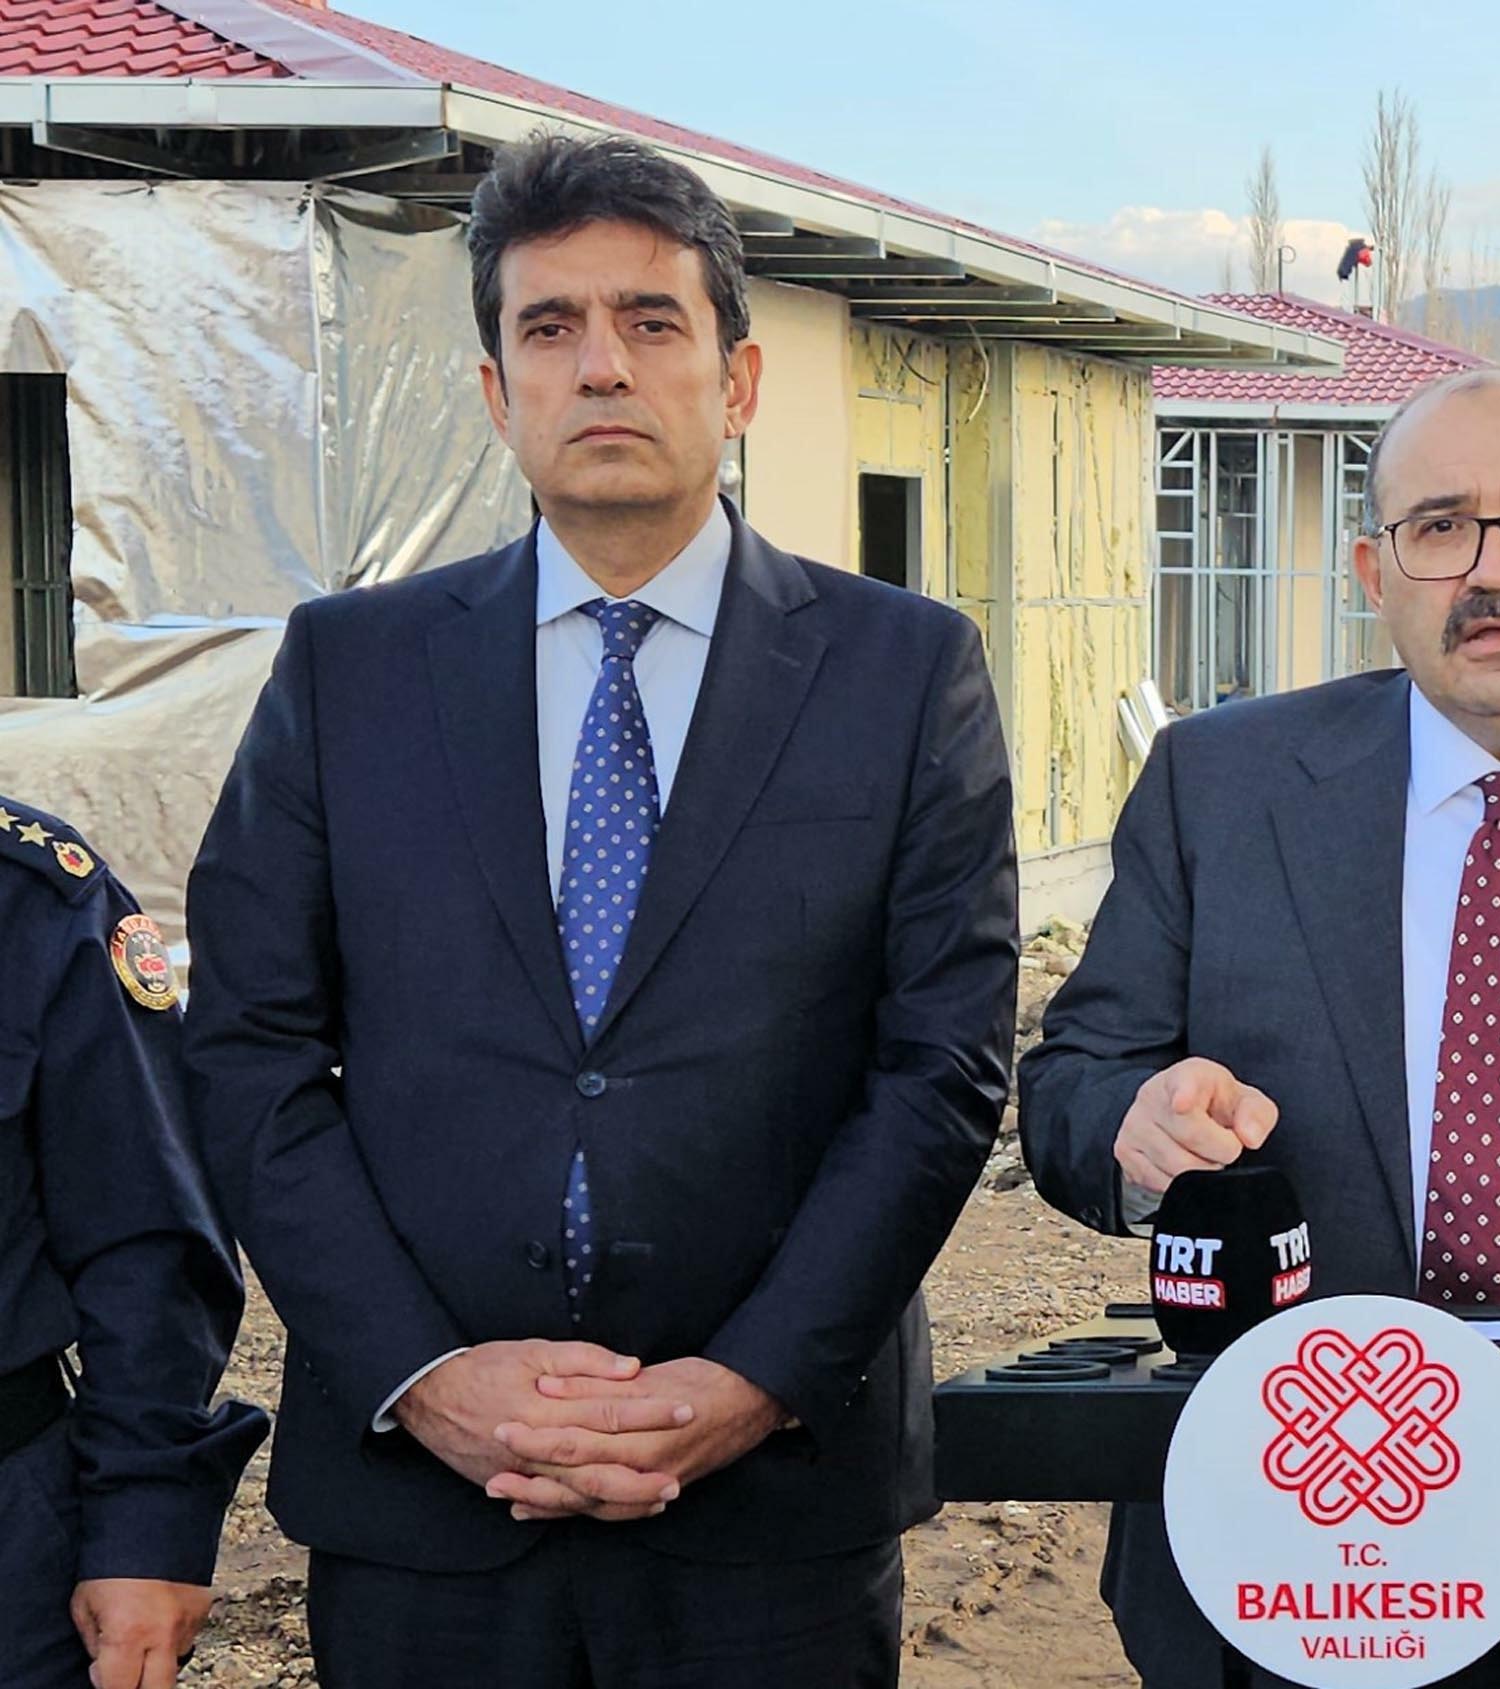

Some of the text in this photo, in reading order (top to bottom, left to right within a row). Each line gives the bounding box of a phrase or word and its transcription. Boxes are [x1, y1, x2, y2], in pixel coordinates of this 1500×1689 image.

[1156, 1234, 1222, 1275] TRT
[1155, 1277, 1221, 1307] HABER
[1338, 1543, 1387, 1567] T.C.
